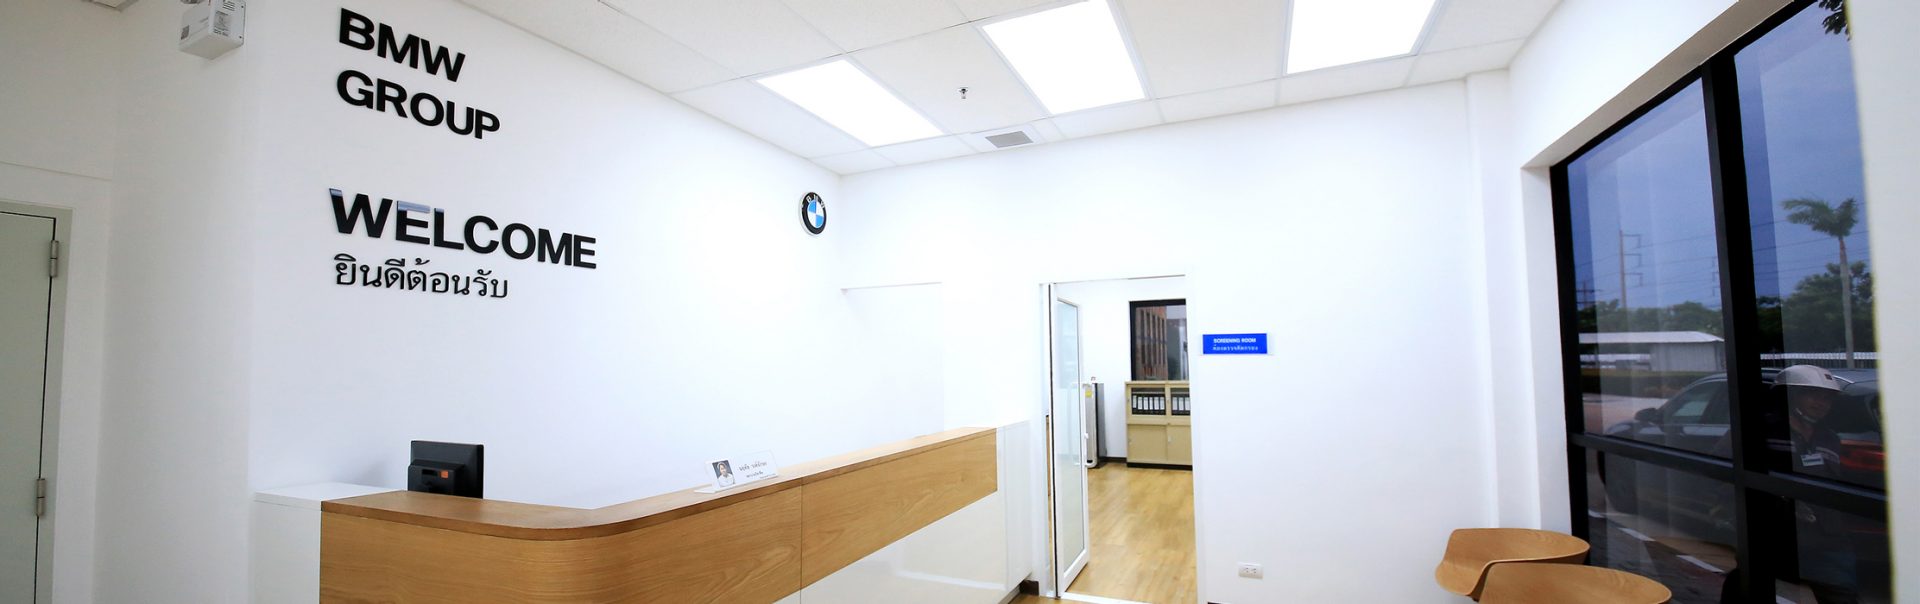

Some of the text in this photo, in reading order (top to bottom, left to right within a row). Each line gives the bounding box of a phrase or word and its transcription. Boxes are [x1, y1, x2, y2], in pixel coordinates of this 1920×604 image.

[338, 7, 466, 83] BMW
[336, 69, 500, 140] GROUP
[329, 187, 597, 269] WELCOME
[333, 253, 509, 299] ยินดีต้อนรับ
